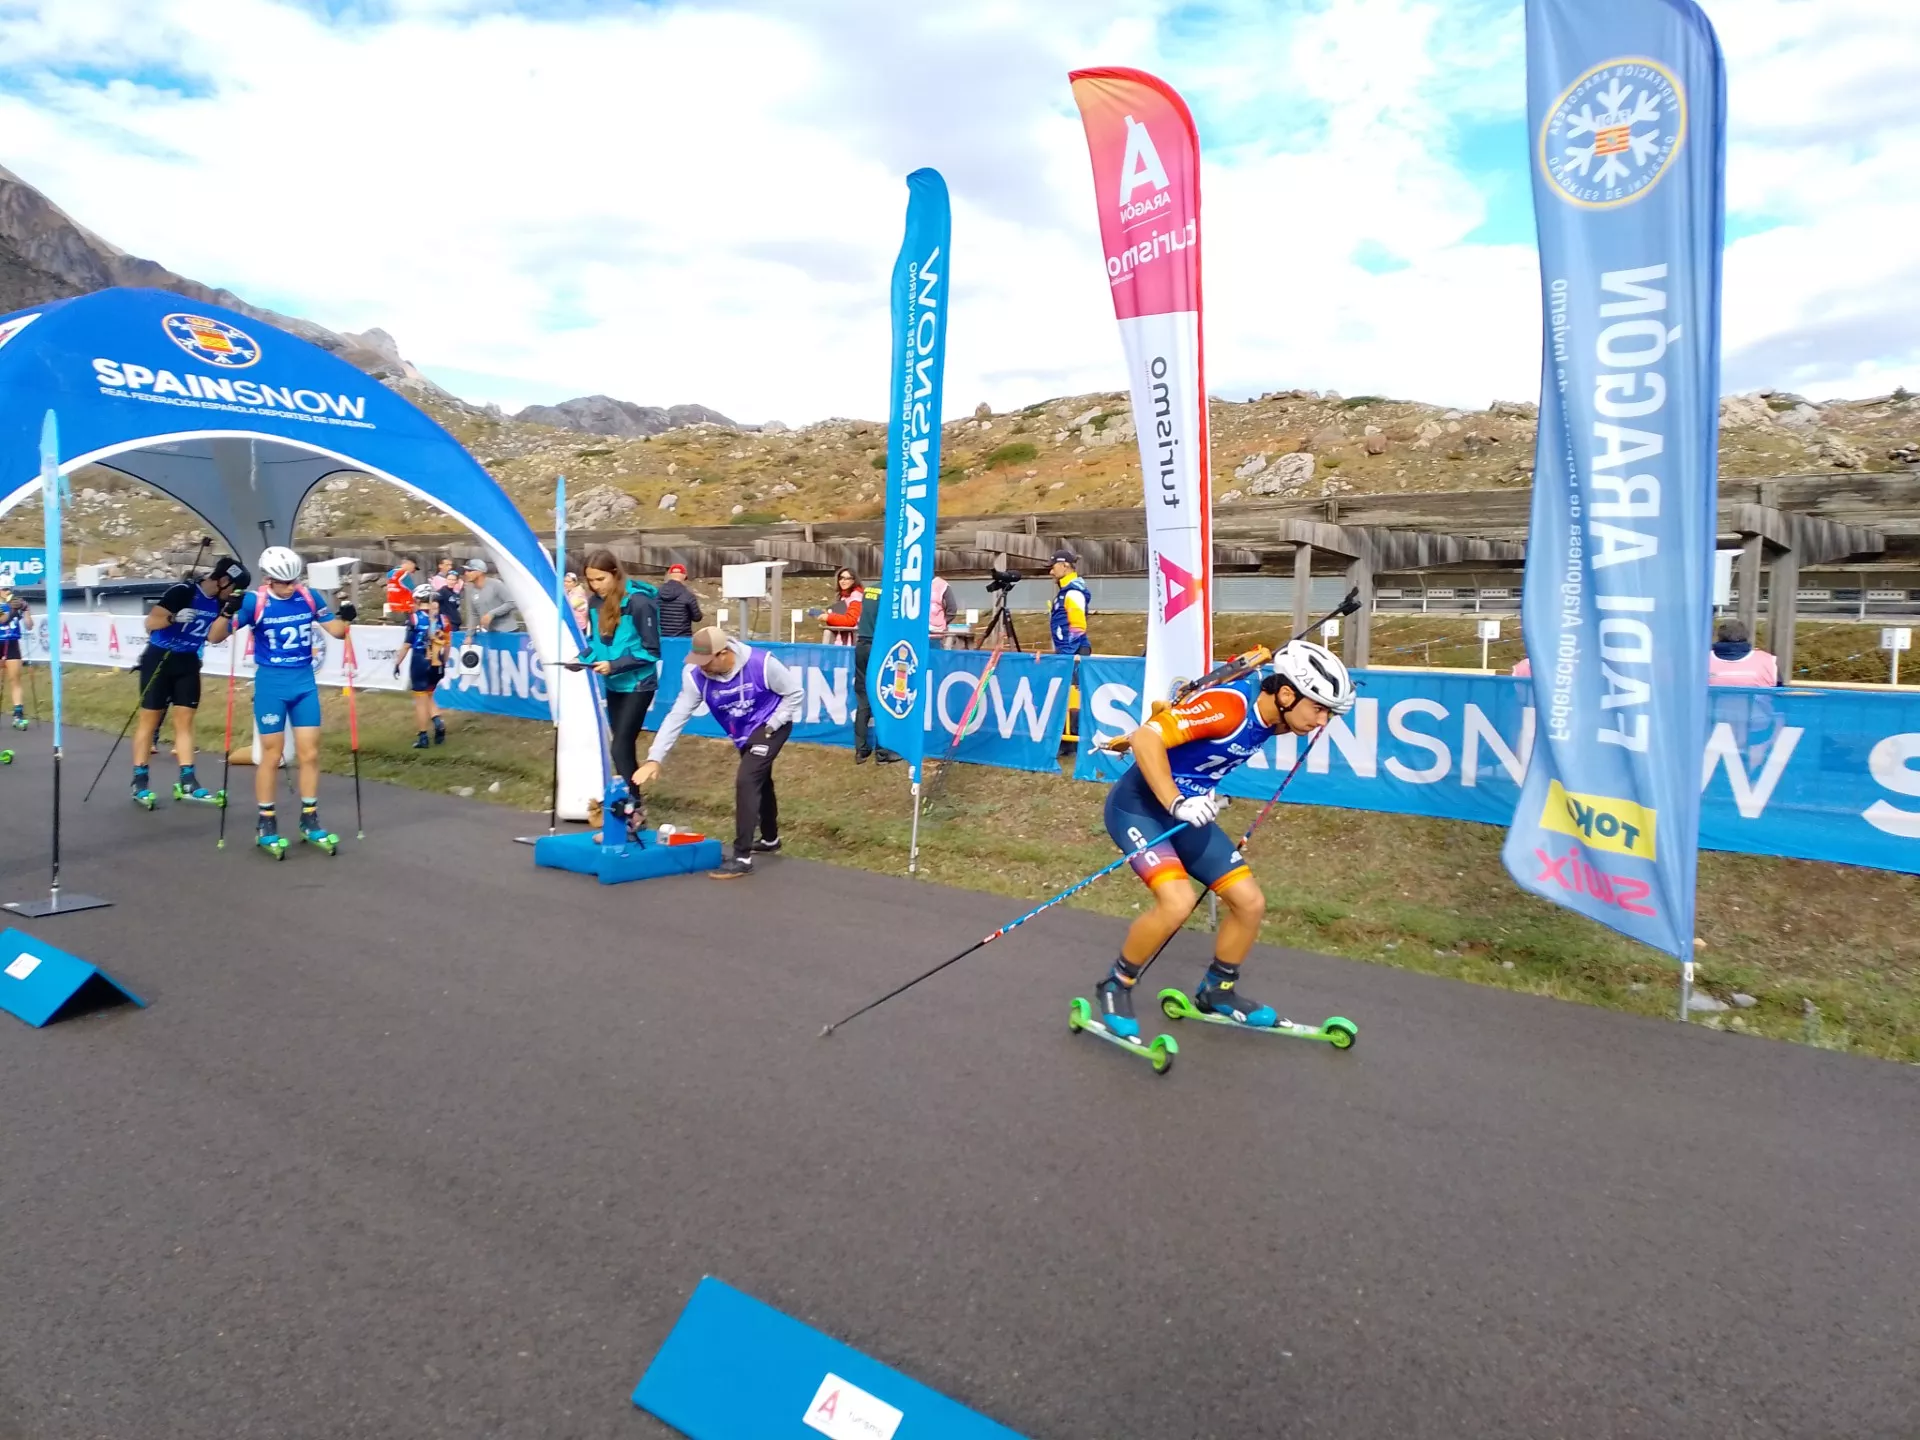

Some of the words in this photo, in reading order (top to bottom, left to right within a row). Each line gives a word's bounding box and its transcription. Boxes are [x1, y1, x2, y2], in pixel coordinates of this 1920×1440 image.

[92, 358, 366, 420] SPAINSNOW
[263, 623, 312, 650] 125
[1294, 667, 1315, 688] 24
